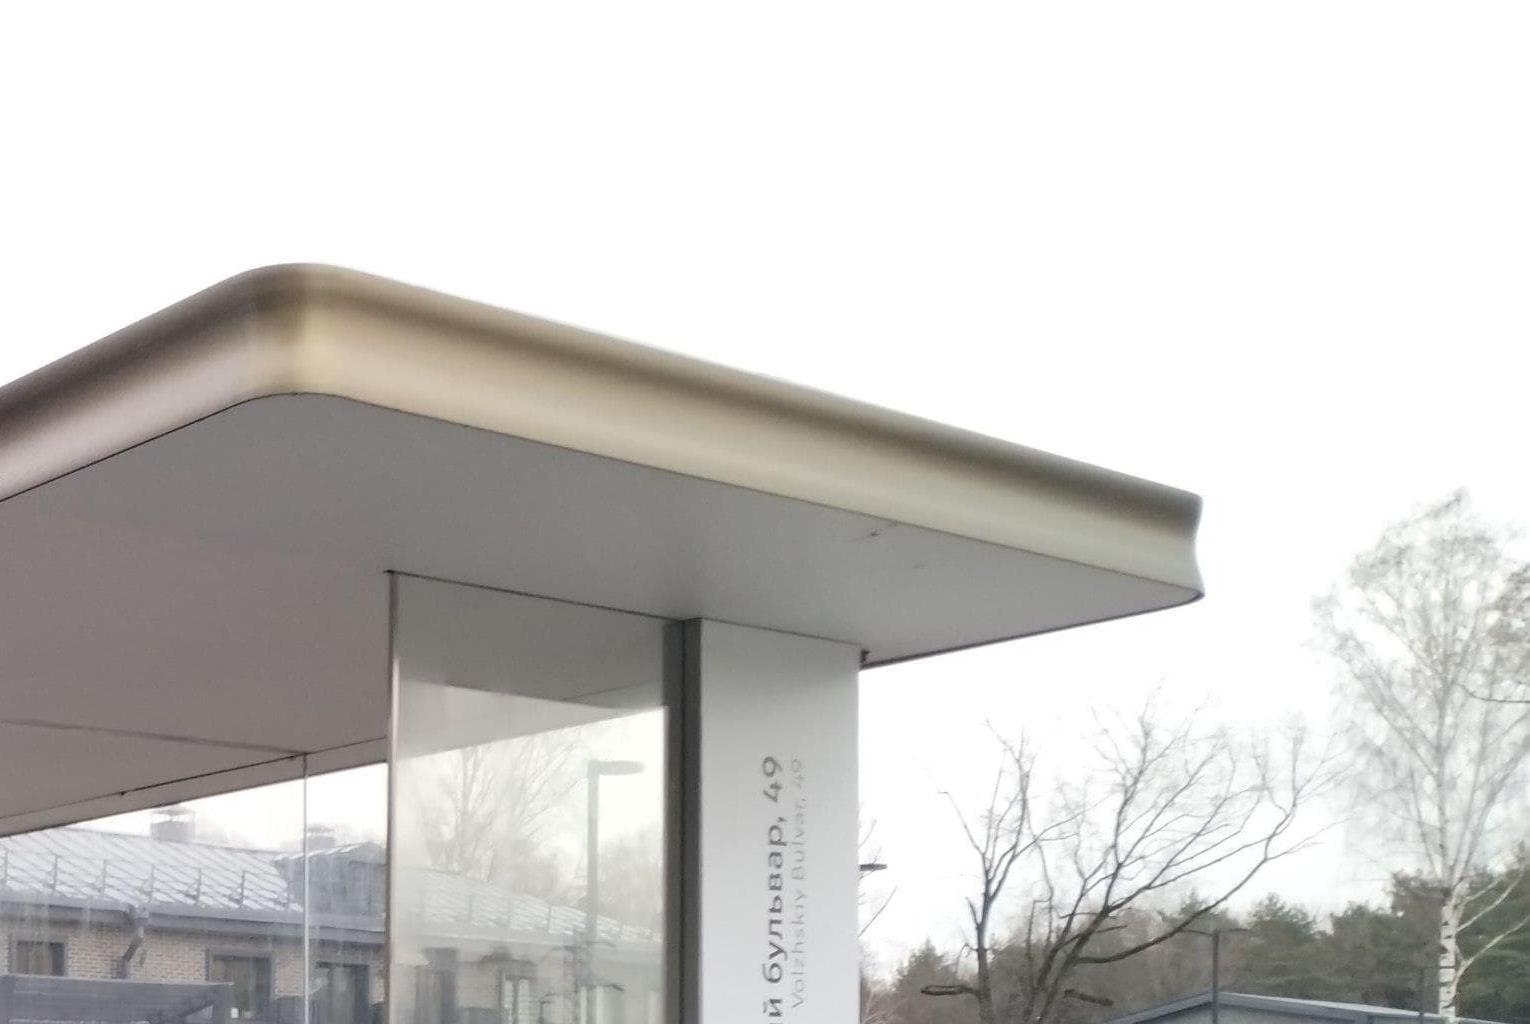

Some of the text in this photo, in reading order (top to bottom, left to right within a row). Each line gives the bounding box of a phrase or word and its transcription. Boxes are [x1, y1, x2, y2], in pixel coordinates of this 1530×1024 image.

[761, 755, 784, 803] 49
[761, 816, 788, 986] бульвар,
[790, 888, 807, 1009] Volzhskiy
